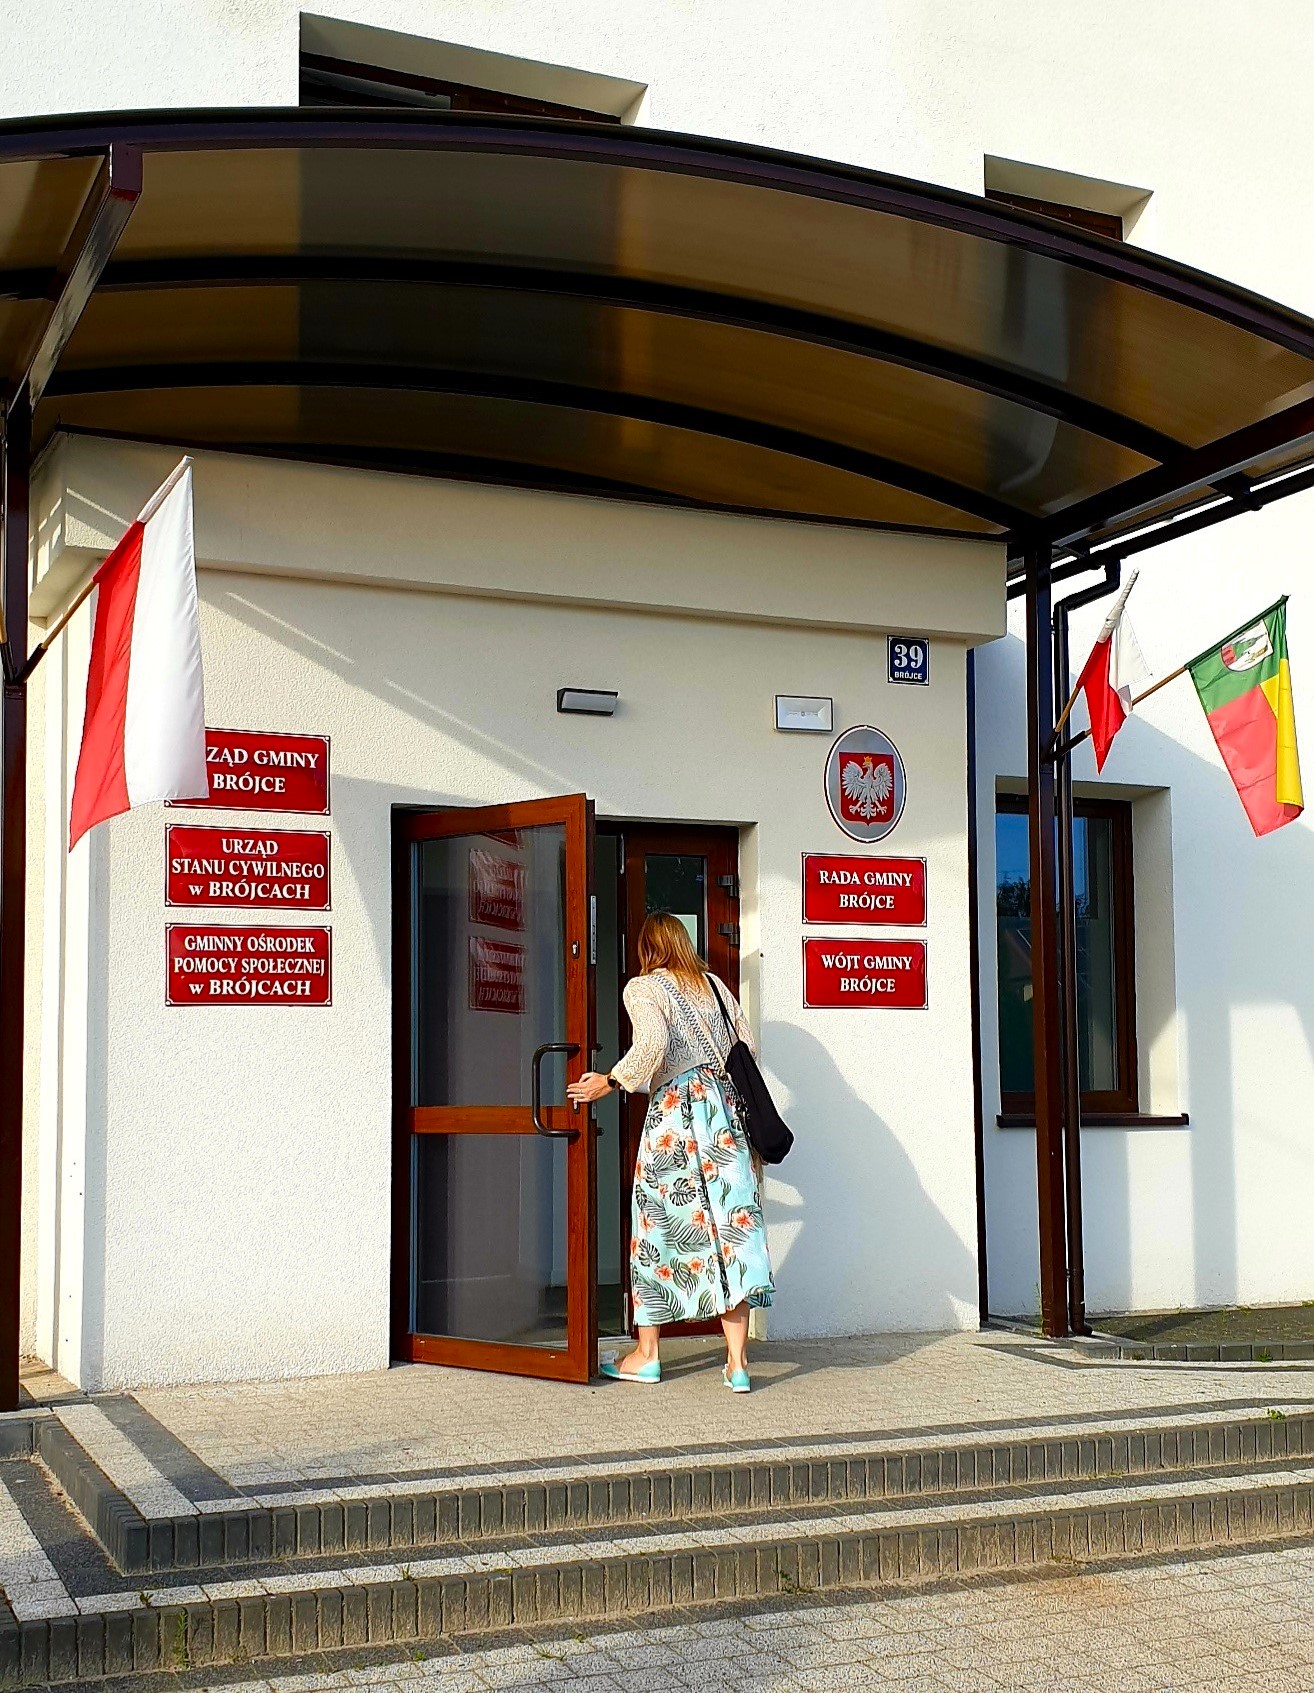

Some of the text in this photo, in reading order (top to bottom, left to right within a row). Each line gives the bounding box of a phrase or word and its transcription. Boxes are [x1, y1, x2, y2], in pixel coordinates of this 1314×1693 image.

[894, 644, 924, 669] 39
[894, 670, 923, 680] BRÓJCE
[206, 746, 319, 769] ZĄD GMINY
[213, 772, 286, 794] BRÓJCE
[221, 838, 279, 858] URZĄD
[171, 858, 325, 879] STANU CYWILNEGO
[819, 870, 913, 887] RADA GMINY
[188, 878, 311, 900] w BRÓJCACH
[839, 891, 895, 911] BRÓJCE
[184, 933, 315, 953] GMINNY OŚRODEK
[173, 957, 325, 977] POMOCY SPOŁECZNEJ
[821, 951, 913, 971] WÓJT GMINY
[188, 976, 311, 998] w BRÓJCACH
[840, 975, 896, 994] BRÓJCE
